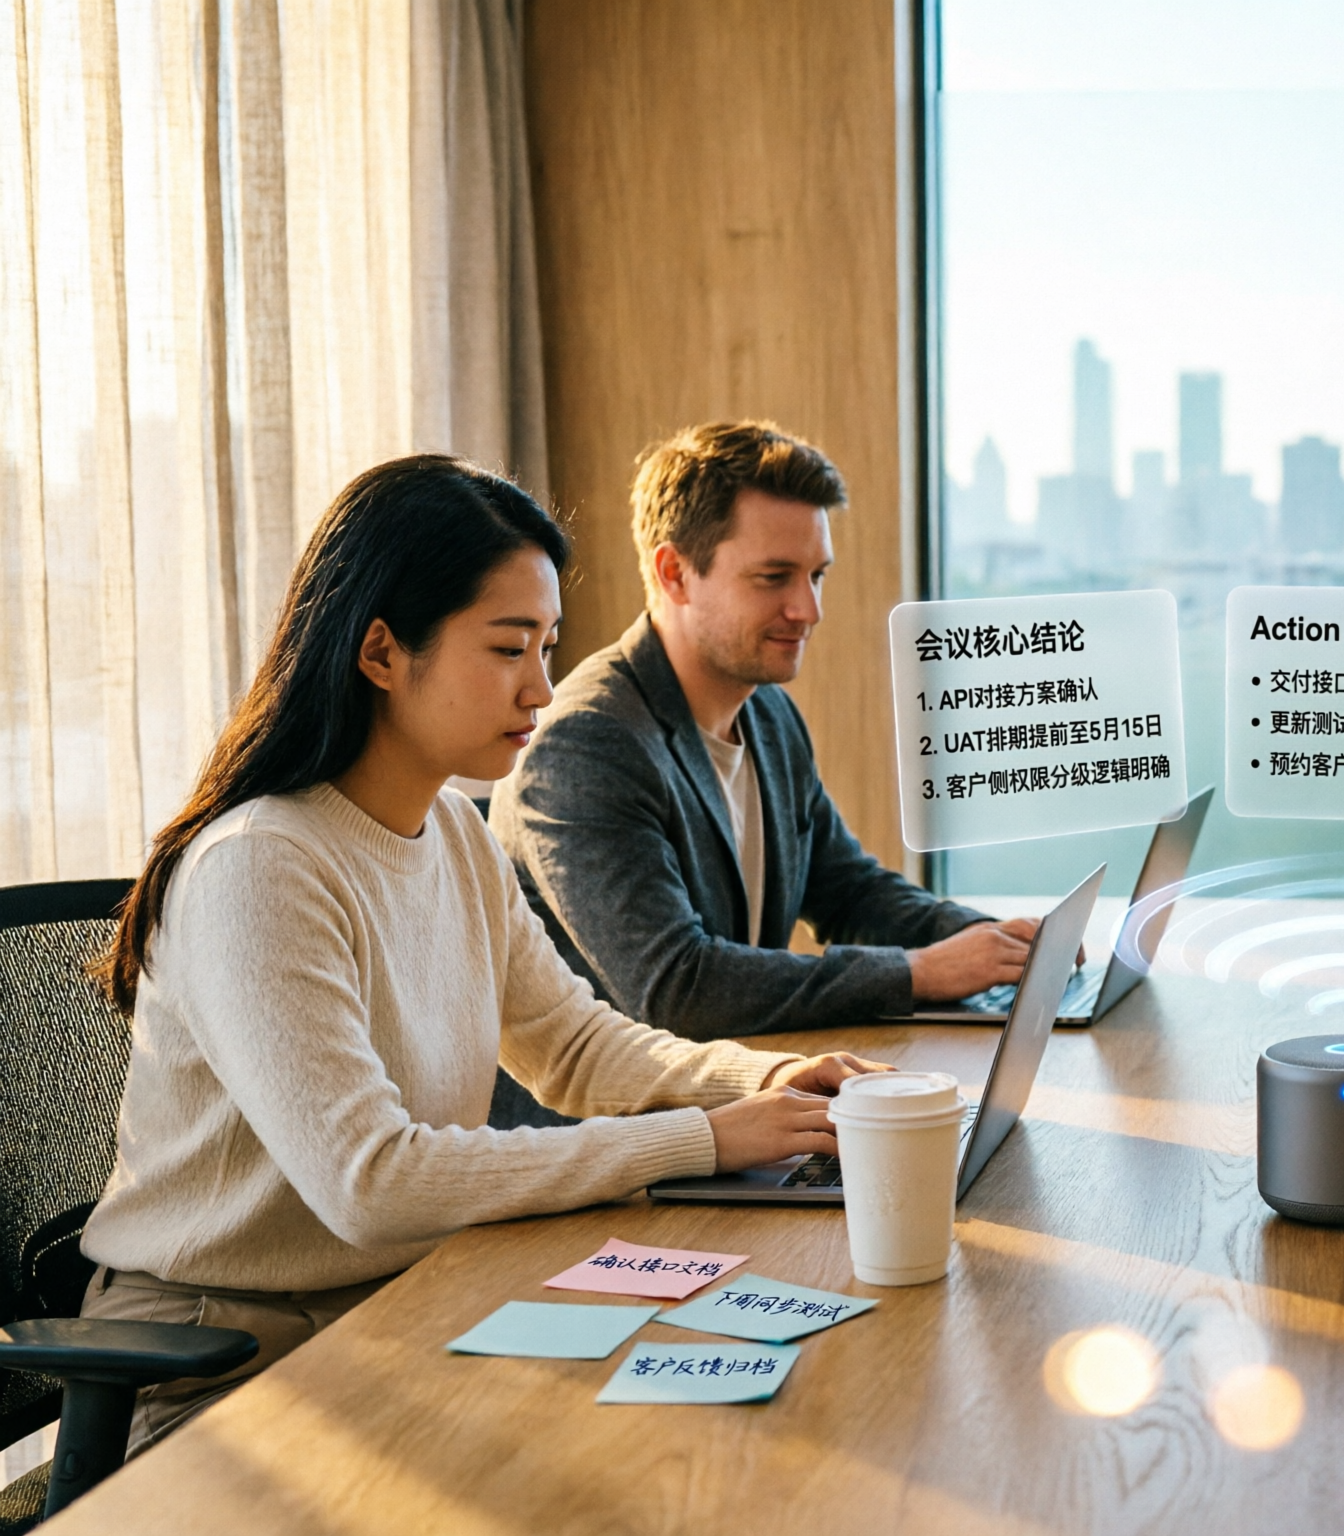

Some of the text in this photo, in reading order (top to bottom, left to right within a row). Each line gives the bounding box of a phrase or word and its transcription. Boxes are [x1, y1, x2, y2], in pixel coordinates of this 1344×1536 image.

[588, 1254, 724, 1277] 确认接口文档
[715, 1291, 850, 1321] 下周同步测试
[630, 1356, 779, 1376] 客户反馈归档
